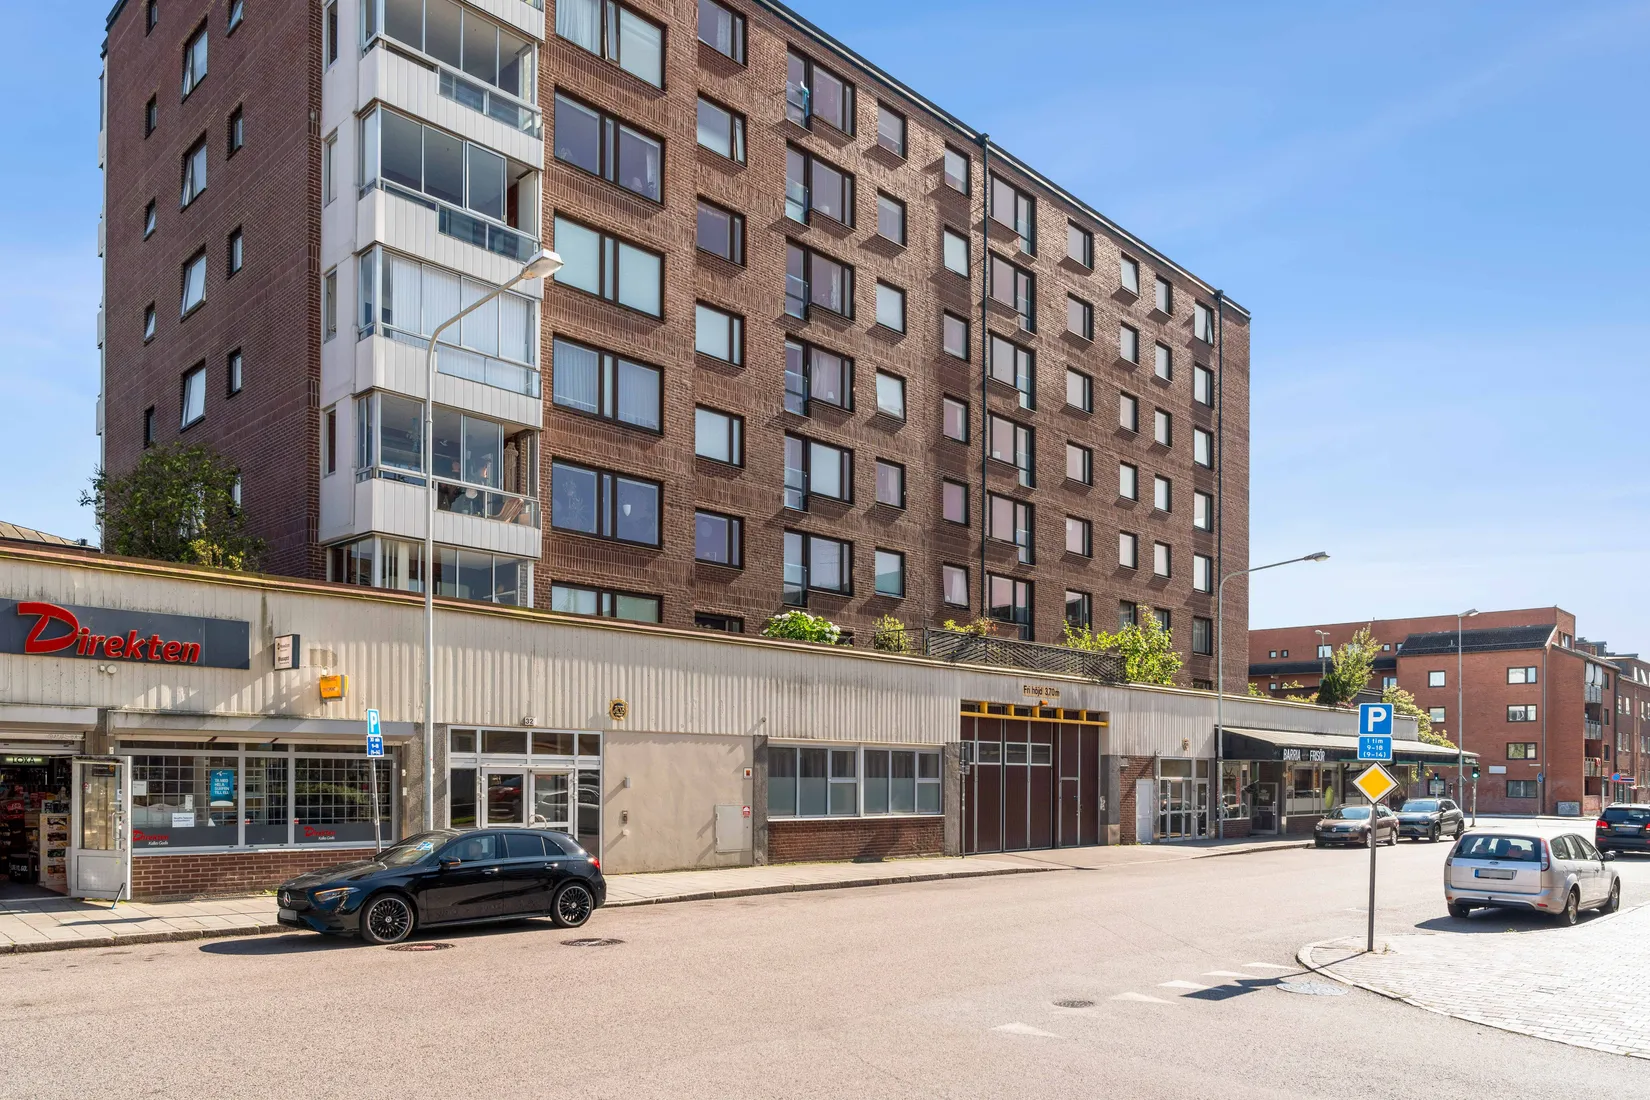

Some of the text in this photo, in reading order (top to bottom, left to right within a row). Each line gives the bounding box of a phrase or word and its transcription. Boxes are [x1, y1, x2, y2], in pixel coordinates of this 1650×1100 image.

[17, 601, 201, 663] Direkten
[1031, 686, 1042, 697] höjd
[370, 711, 378, 733] P
[1368, 706, 1387, 732] P
[12, 756, 36, 764] LOXA
[1283, 748, 1326, 762] BARRIA FRISÖR
